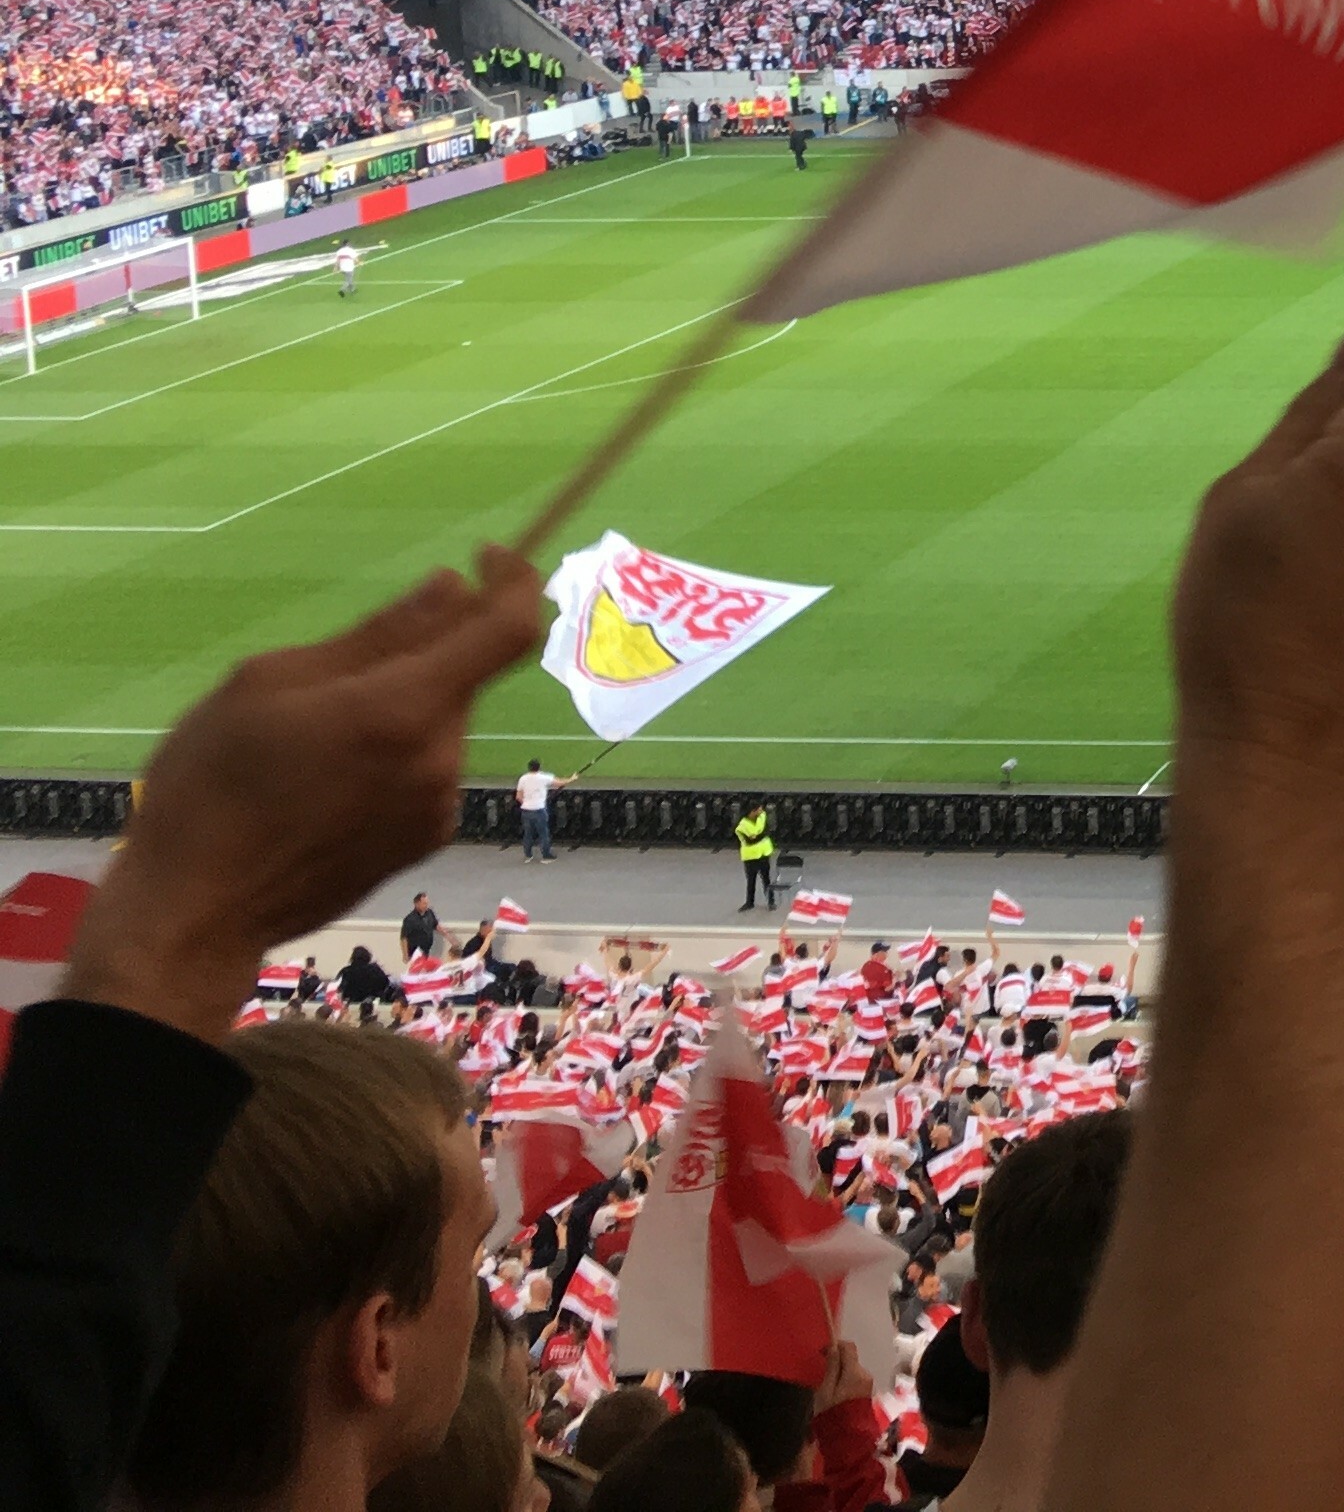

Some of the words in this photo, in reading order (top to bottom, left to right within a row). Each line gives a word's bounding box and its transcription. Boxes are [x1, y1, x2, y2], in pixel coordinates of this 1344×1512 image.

[366, 149, 418, 180] UNIBET
[426, 135, 475, 165] UNIBET
[180, 196, 238, 231] UNIBET
